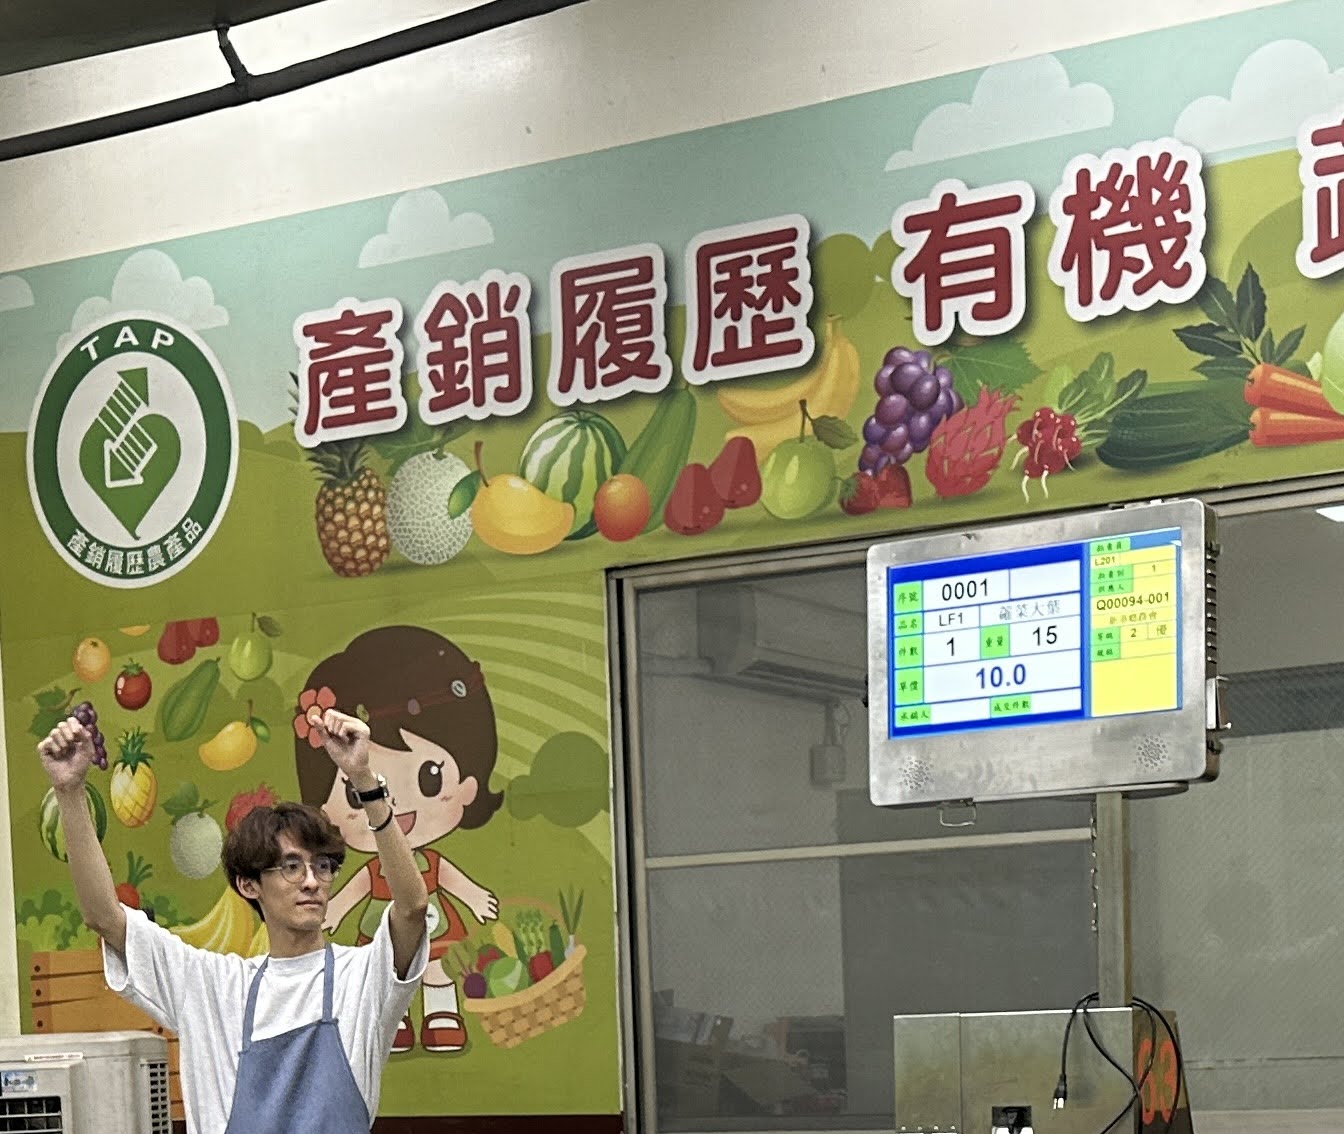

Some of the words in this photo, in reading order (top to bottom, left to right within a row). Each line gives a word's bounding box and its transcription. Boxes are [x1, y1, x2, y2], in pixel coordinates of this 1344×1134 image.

[301, 224, 805, 438] 產銷履歷
[902, 151, 1193, 333] 有機
[79, 325, 176, 361] TAP
[66, 516, 204, 577] 產銷履歷農產品
[941, 577, 989, 602] 0001
[1096, 591, 1170, 611] Q00094-001
[938, 612, 964, 627] LF1
[946, 636, 956, 657] 1
[1032, 625, 1058, 647] 15
[976, 663, 1027, 690] 10.0
